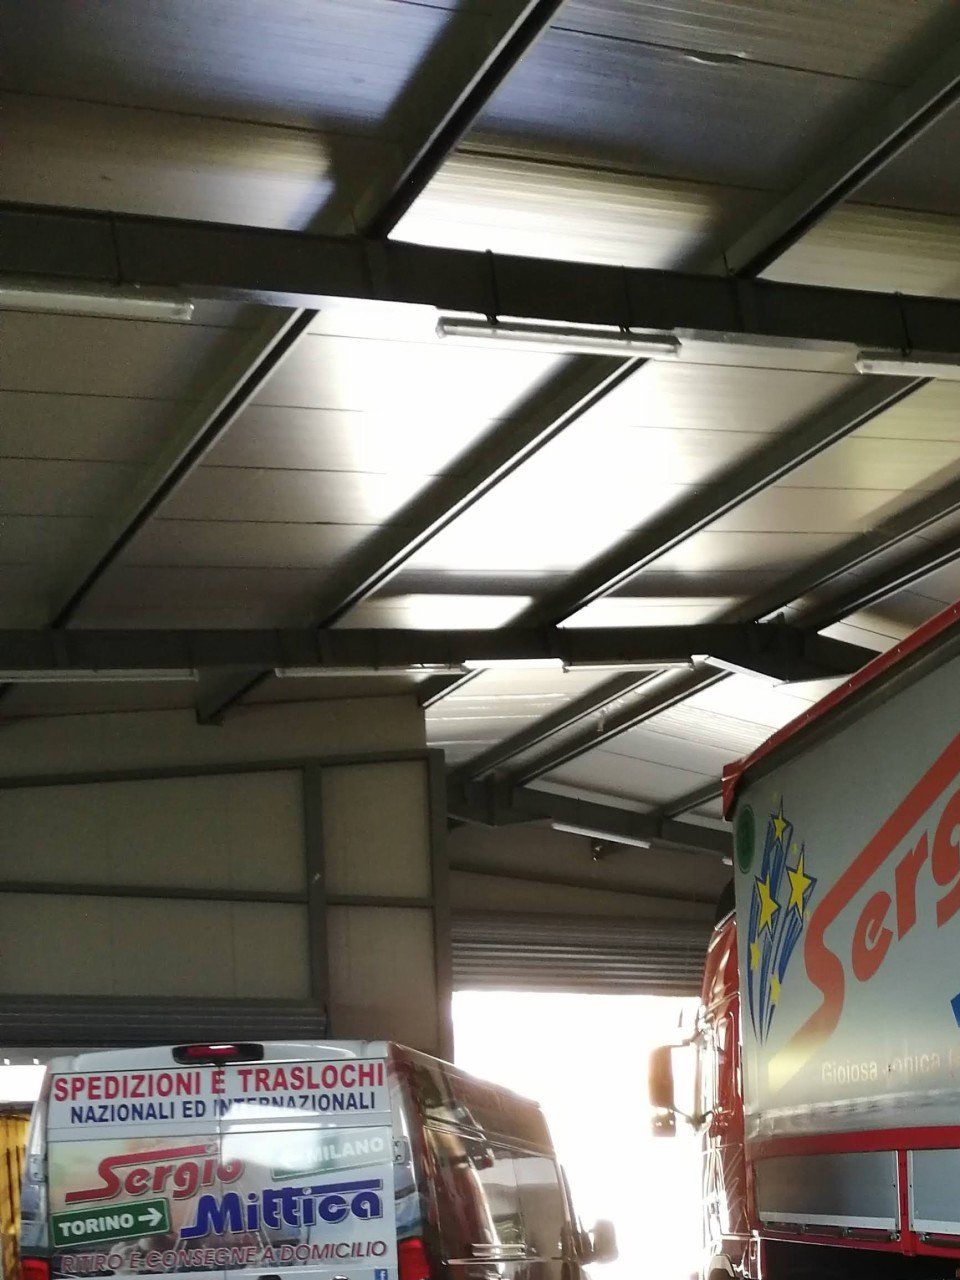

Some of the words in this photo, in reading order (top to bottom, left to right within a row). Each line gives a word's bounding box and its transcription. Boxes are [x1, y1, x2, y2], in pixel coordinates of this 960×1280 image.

[54, 1071, 201, 1103] SPEDIZIONI
[211, 1069, 225, 1094] E
[237, 1063, 384, 1092] TRASLOCHI
[70, 1101, 175, 1125] NAZIONALI
[182, 1099, 206, 1119] ED
[65, 1143, 245, 1204] Sergio
[58, 1213, 135, 1237] TORINO
[180, 1178, 384, 1239] Mittica
[60, 1252, 123, 1274] RITIRO
[147, 1246, 258, 1270] CONSEGNE
[260, 1245, 278, 1262] A
[279, 1240, 388, 1262] DOMICILIO
